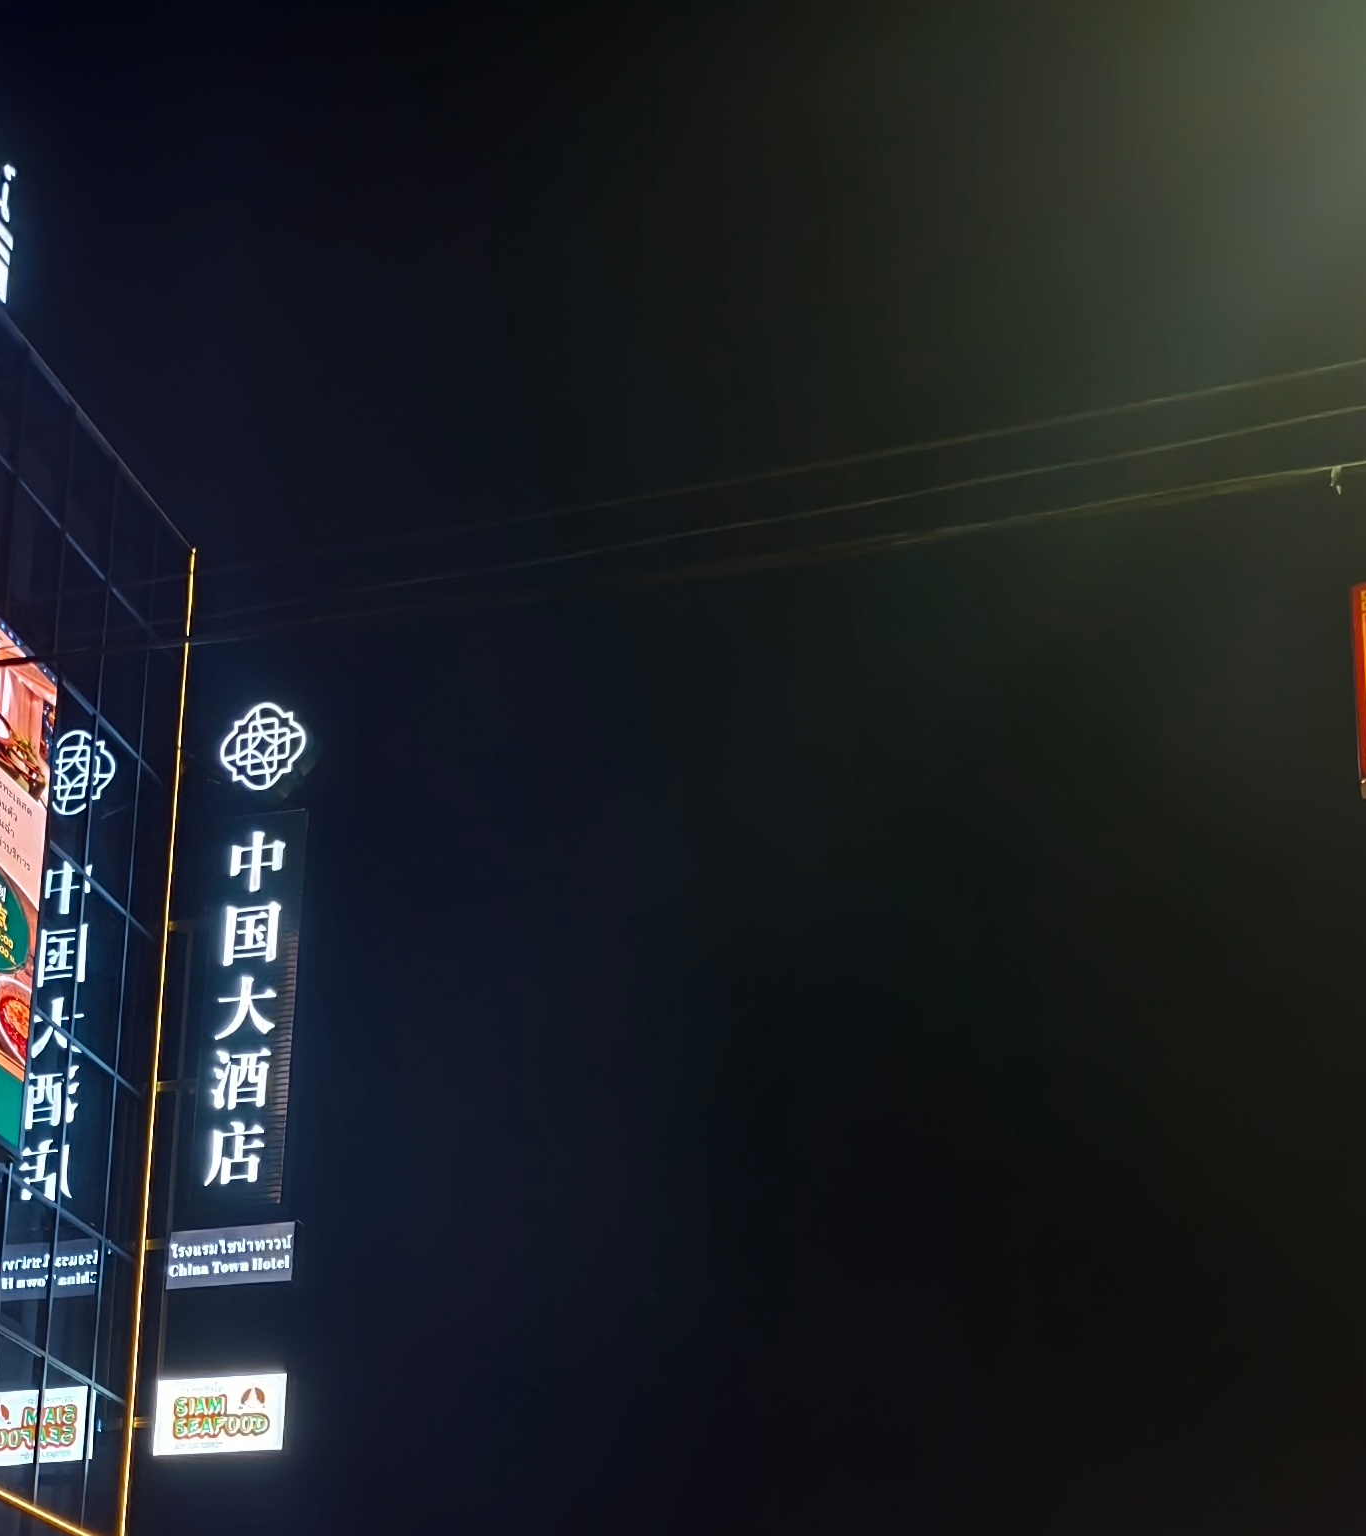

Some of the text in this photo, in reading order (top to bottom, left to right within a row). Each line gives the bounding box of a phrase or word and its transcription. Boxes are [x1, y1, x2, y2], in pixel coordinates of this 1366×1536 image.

[203, 830, 287, 1188] 中国大酒店
[168, 1256, 291, 1279] China Town Hotel
[174, 1395, 227, 1418] SIAM
[174, 1414, 271, 1439] SEAFOOD
